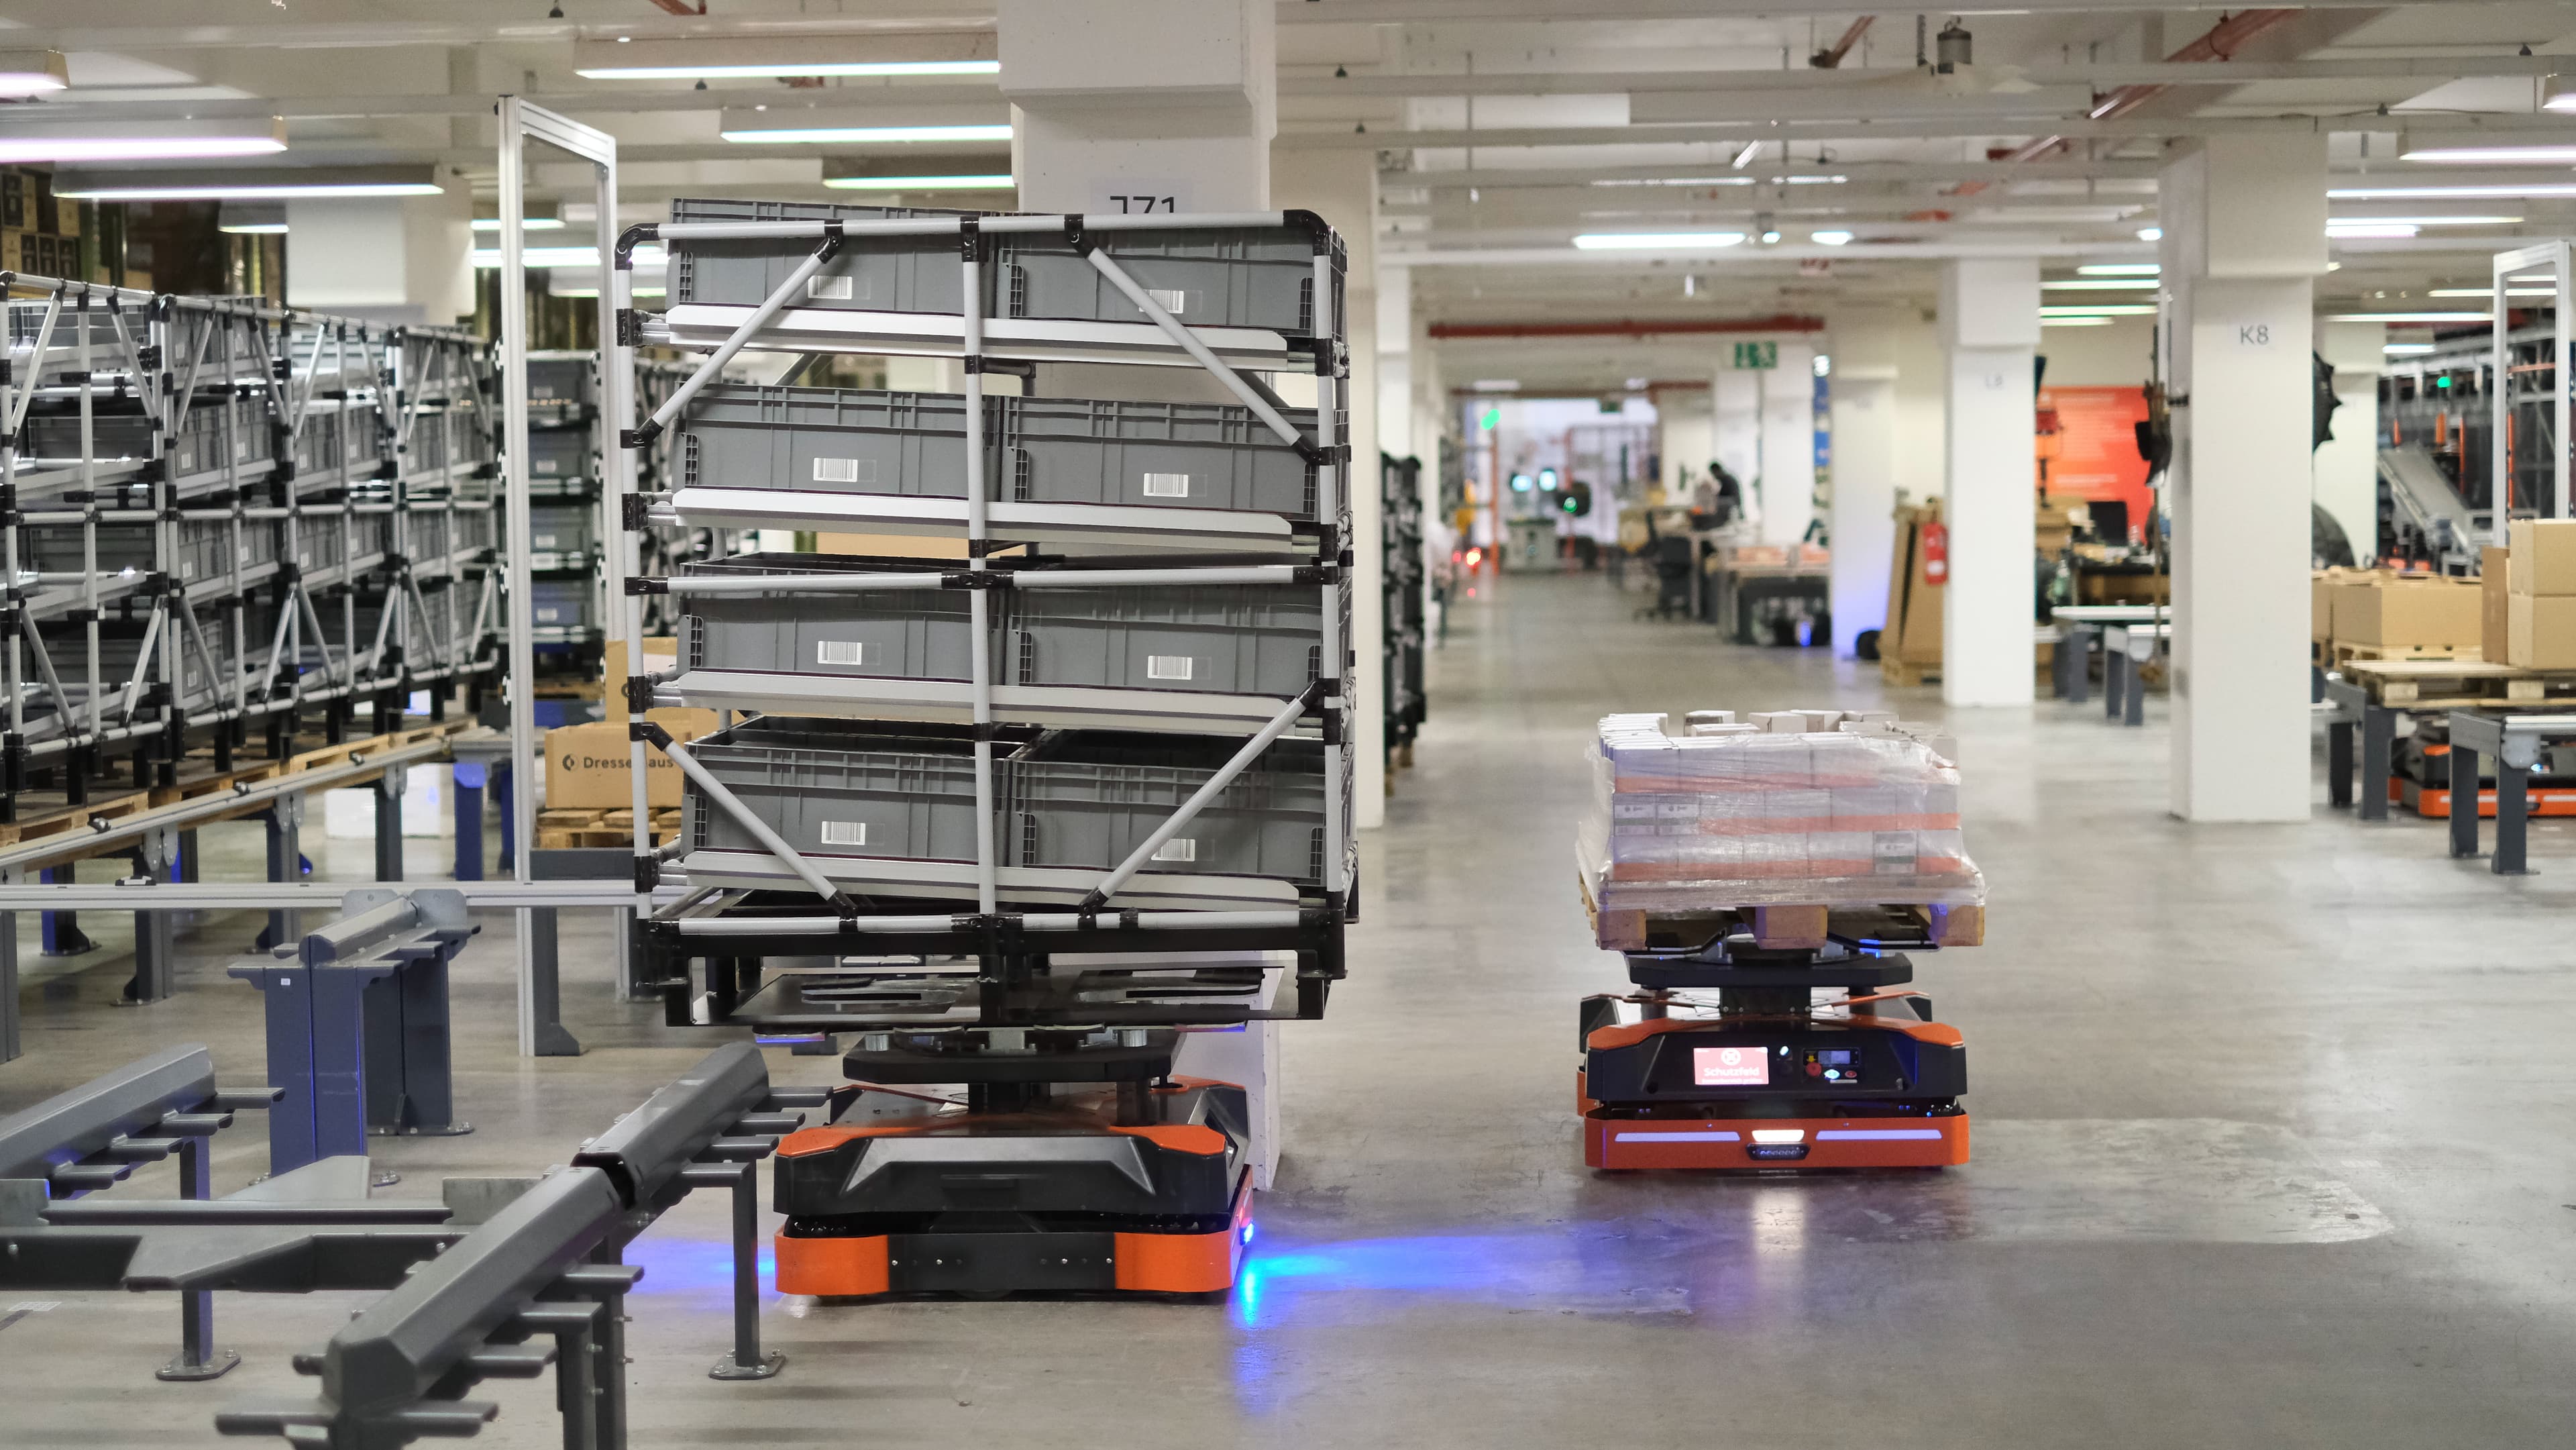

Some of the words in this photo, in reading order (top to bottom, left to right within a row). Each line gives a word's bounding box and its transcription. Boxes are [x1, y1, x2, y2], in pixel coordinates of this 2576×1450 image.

[2241, 325, 2268, 344] K8
[584, 757, 674, 769] Dresseaus
[1704, 1067, 1760, 1076] Schutzfeld
